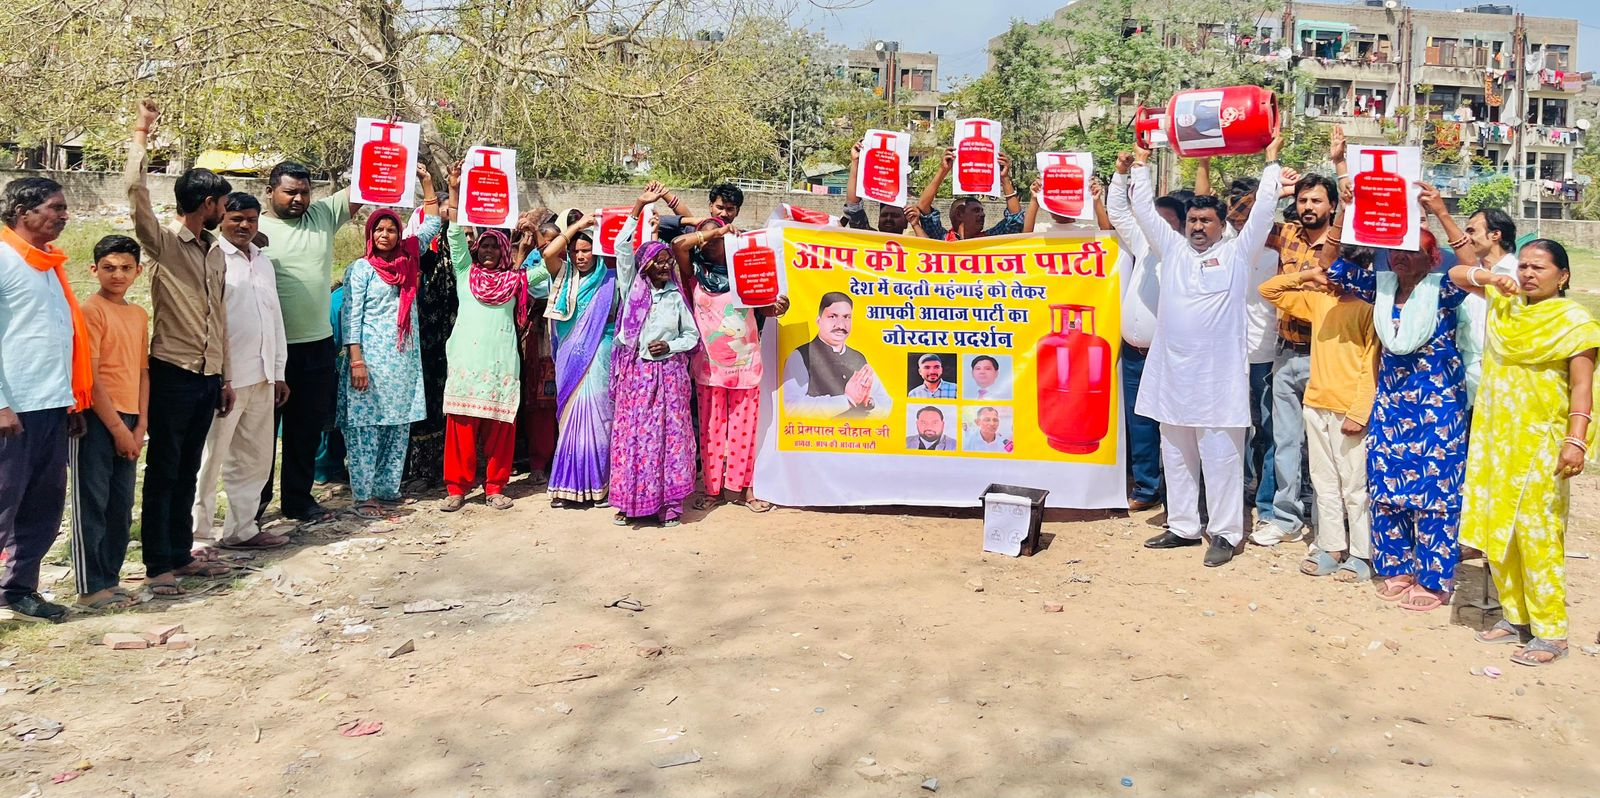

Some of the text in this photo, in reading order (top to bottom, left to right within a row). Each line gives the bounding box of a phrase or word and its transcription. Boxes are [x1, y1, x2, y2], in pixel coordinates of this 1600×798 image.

[792, 241, 1106, 277] आप की आवाज पार्टी
[851, 278, 1046, 300] देश में बढ़ती महंगाई को लेकर
[867, 302, 1029, 323] आपकी आवाज पार्टी का
[884, 325, 1012, 347] जोरदार प्रदर्शन
[784, 422, 890, 438] श्री प्रेमपाल चौहान जी
